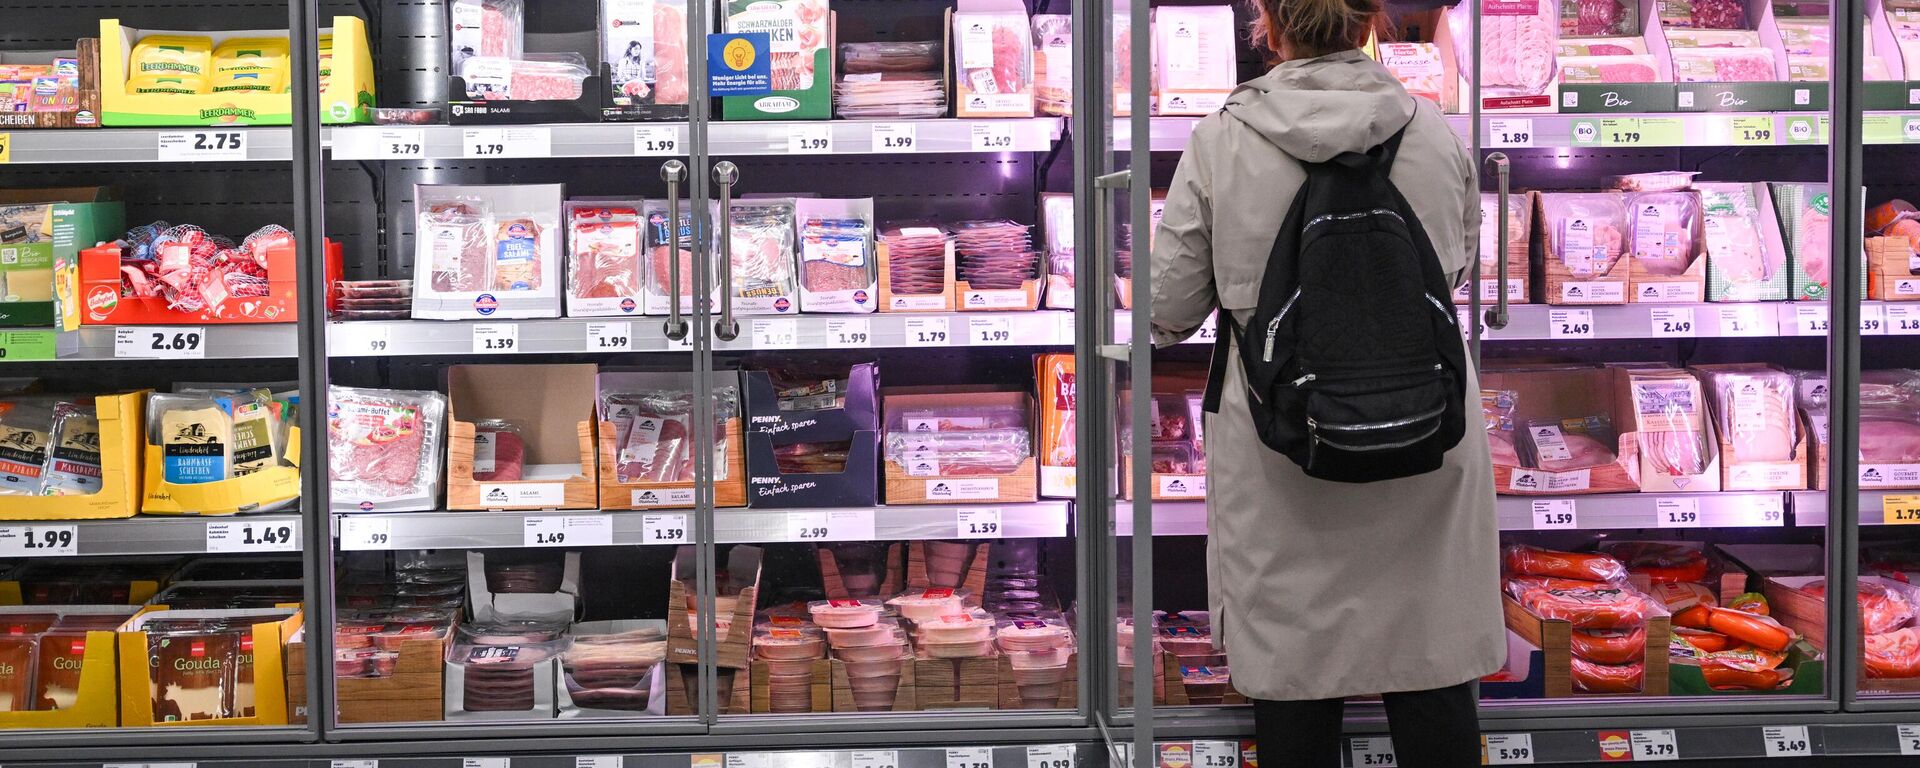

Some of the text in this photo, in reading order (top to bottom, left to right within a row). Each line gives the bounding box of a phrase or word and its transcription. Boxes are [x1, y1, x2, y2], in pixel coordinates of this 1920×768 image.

[141, 62, 201, 75] LEERDAMMER
[1600, 92, 1633, 107] Bio
[1715, 92, 1748, 107] Bio
[200, 107, 257, 120] LEERDAMMER
[1502, 133, 1529, 143] 1.89
[1613, 132, 1640, 142] 1.79
[1744, 130, 1770, 140] 1.99
[194, 133, 241, 149] 2.75
[647, 141, 674, 151] 1.99
[800, 139, 828, 149] 1.99
[884, 137, 912, 147] 1.99
[984, 137, 1011, 146] 1.49
[392, 144, 420, 154] 3.79
[476, 145, 504, 155] 1.79
[1562, 324, 1589, 334] 2.49
[1663, 322, 1690, 332] 2.49
[839, 333, 867, 343] 1.99
[918, 332, 946, 342] 1.79
[982, 331, 1009, 341] 1.99
[152, 333, 200, 350] 2.69
[486, 339, 514, 349] 1.39
[600, 337, 627, 347] 1.99
[752, 415, 782, 423] PENNY.
[759, 418, 817, 435] Einfach sparen
[180, 445, 209, 455] Lindenhof
[752, 477, 782, 485] PENNY.
[758, 481, 817, 496] Einfach sparen
[1545, 514, 1572, 524] 1.59
[1669, 512, 1696, 522] 1.59
[800, 528, 828, 538] 2.99
[970, 523, 997, 533] 1.39
[243, 527, 291, 545] 1.49
[537, 532, 565, 543] 1.49
[655, 529, 683, 539] 1.39
[24, 530, 72, 549] 1.99
[174, 656, 221, 671] Gouda
[1645, 744, 1674, 755] 3.79
[1777, 740, 1806, 752] 3.49
[1364, 753, 1393, 764] 3.79
[1500, 748, 1529, 759] 5.99
[1205, 755, 1235, 767] 1.39
